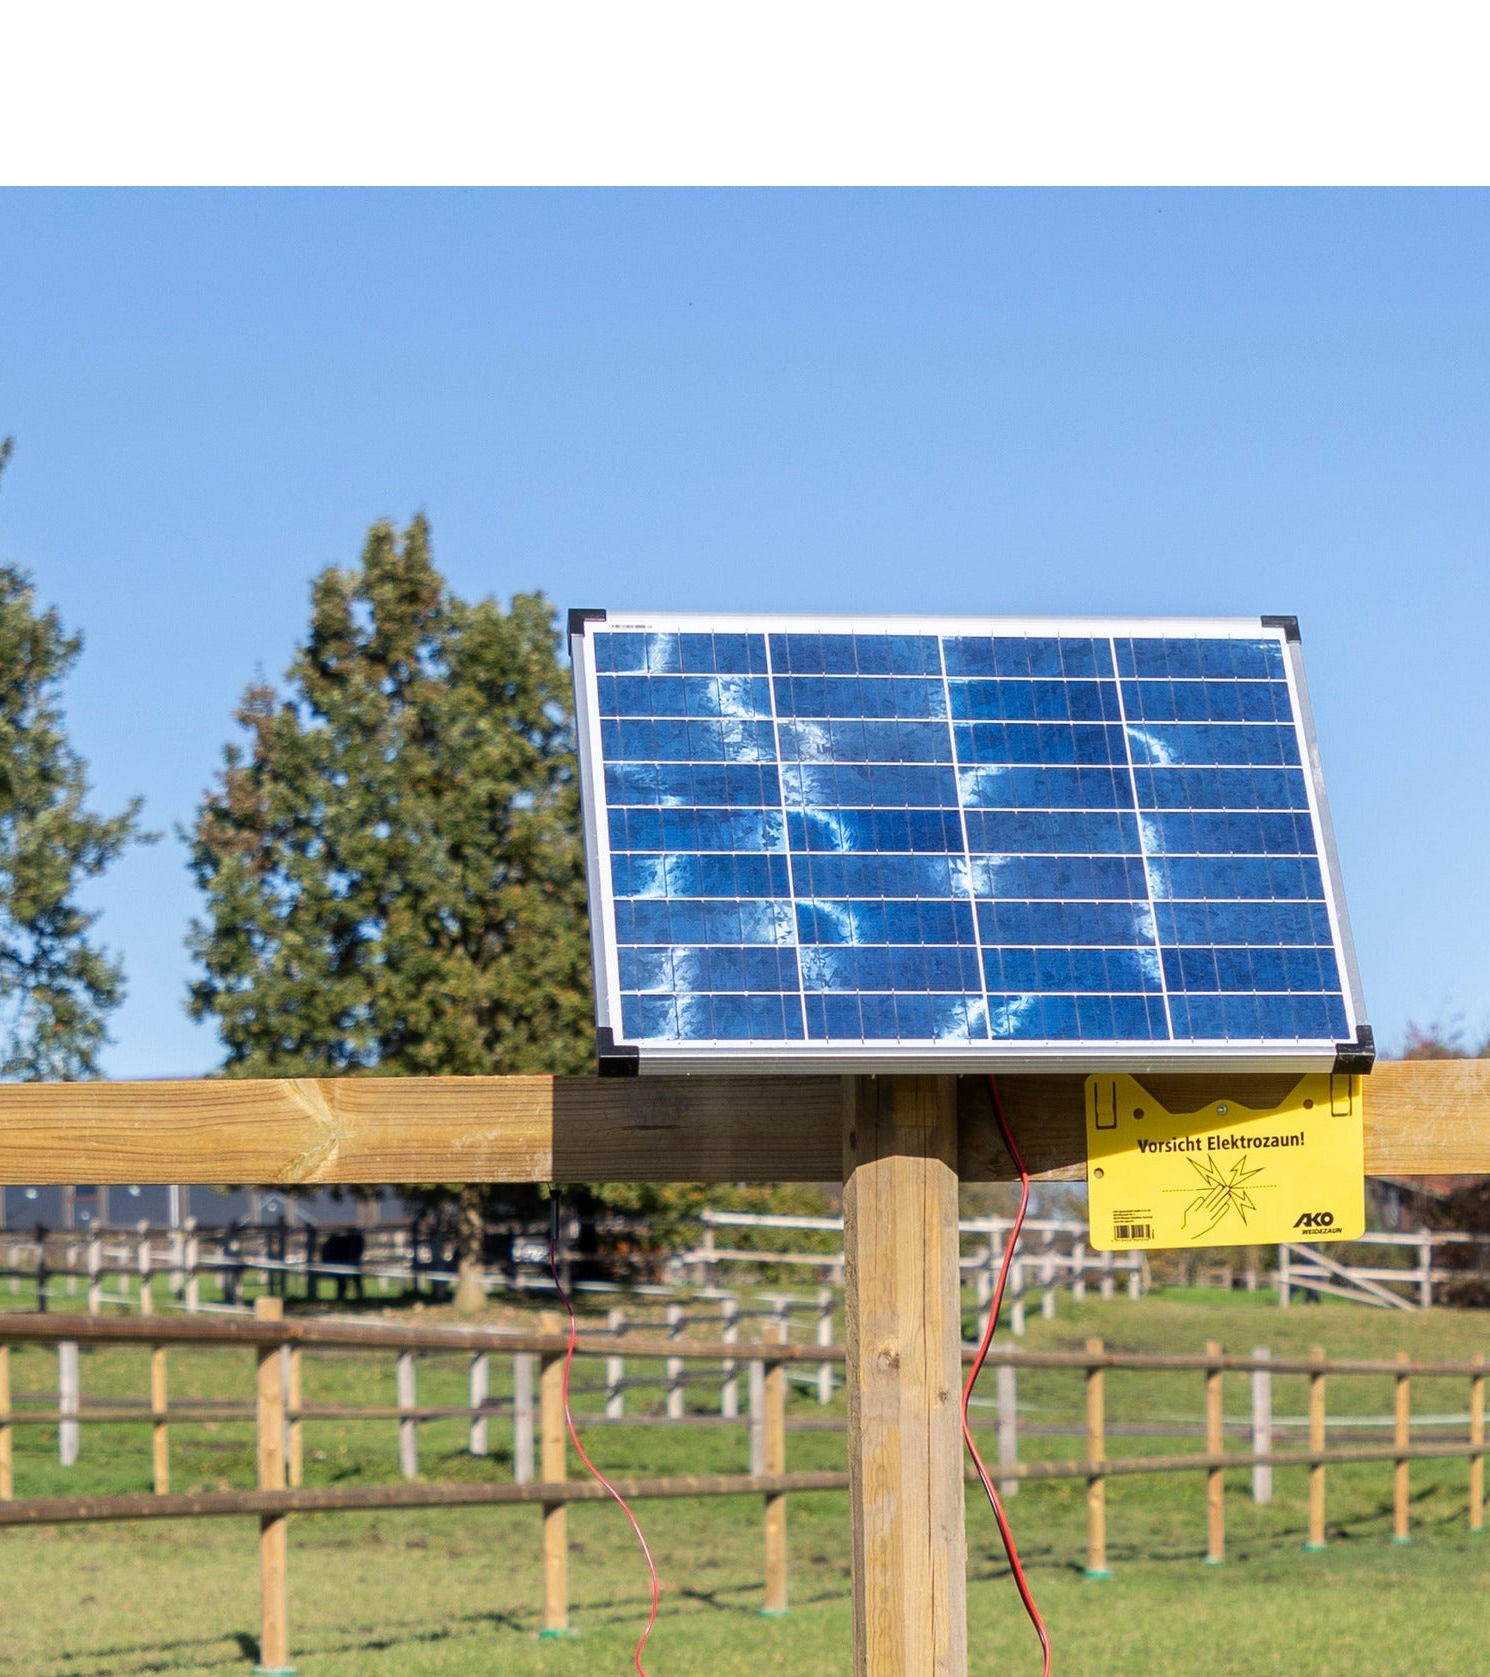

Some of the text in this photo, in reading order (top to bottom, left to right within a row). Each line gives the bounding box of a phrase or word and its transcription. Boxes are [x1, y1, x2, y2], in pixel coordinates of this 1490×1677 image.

[1137, 1132, 1305, 1154] Vorsicht Elektrozaun!
[1293, 1211, 1334, 1228] AKO
